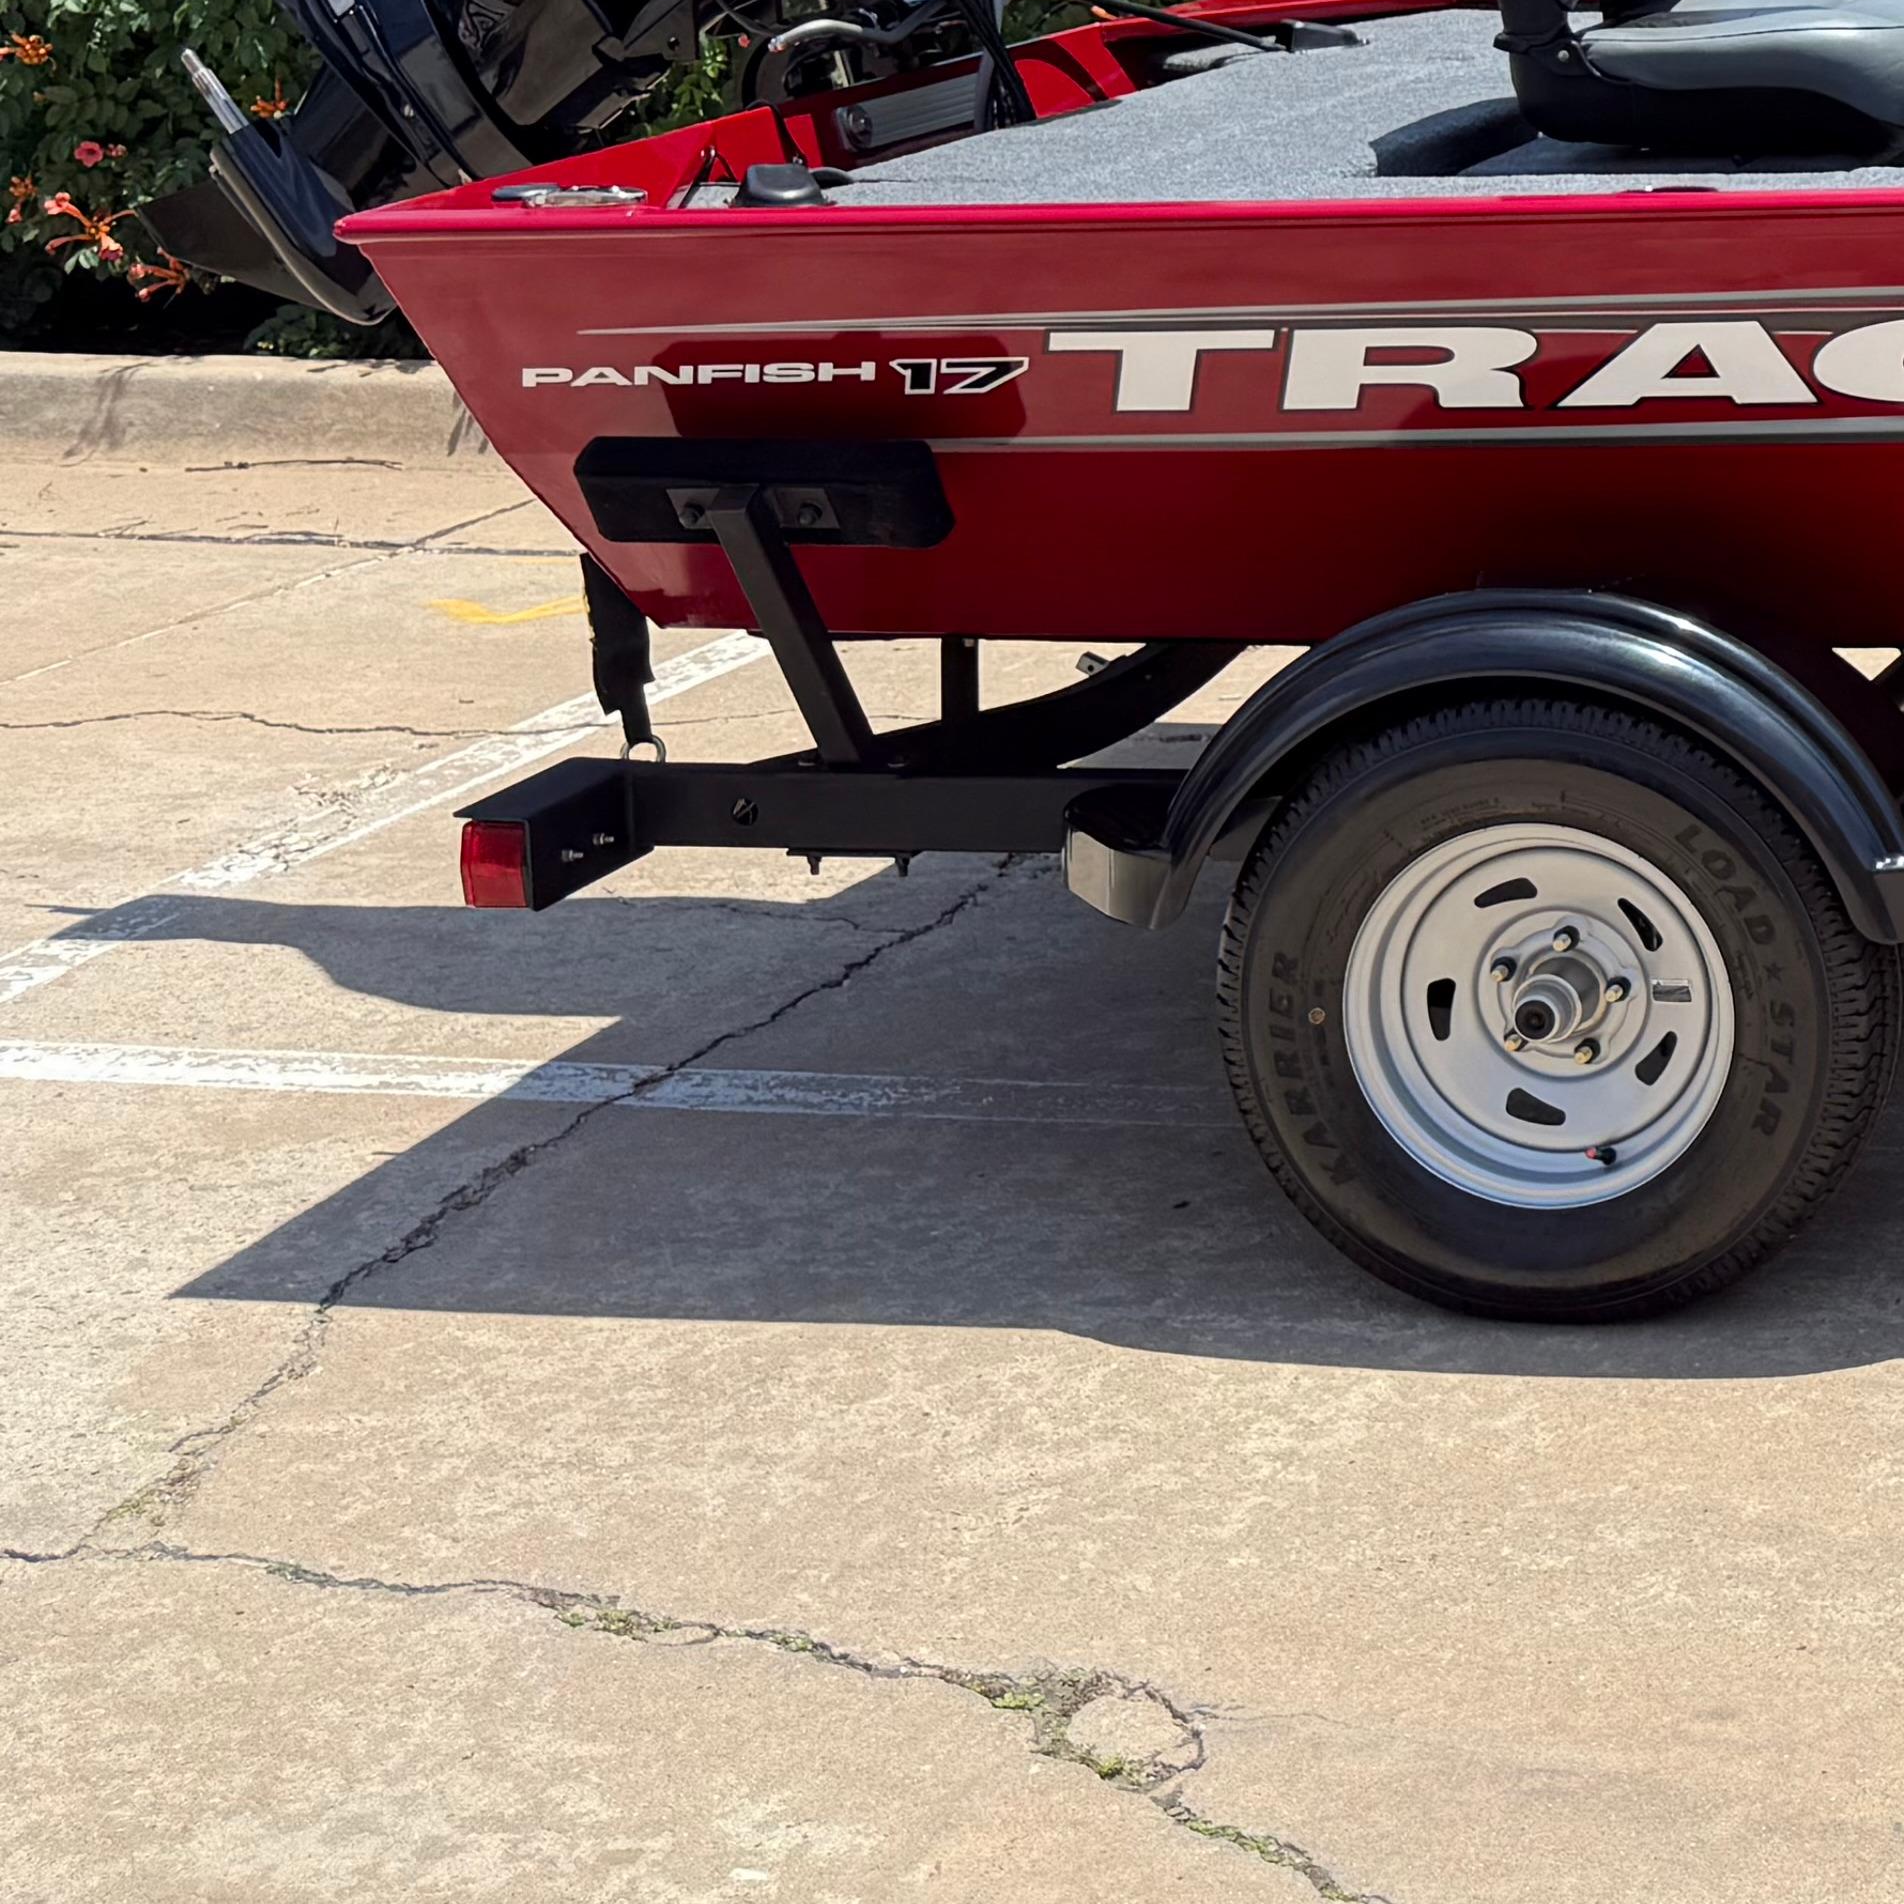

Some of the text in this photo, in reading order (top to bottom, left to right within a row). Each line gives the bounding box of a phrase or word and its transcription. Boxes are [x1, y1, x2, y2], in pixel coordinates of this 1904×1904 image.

[521, 356, 1030, 395] PANFISH 17
[1268, 951, 1358, 1186] KARRIER
[1675, 824, 1796, 1137] LOAD STAR
